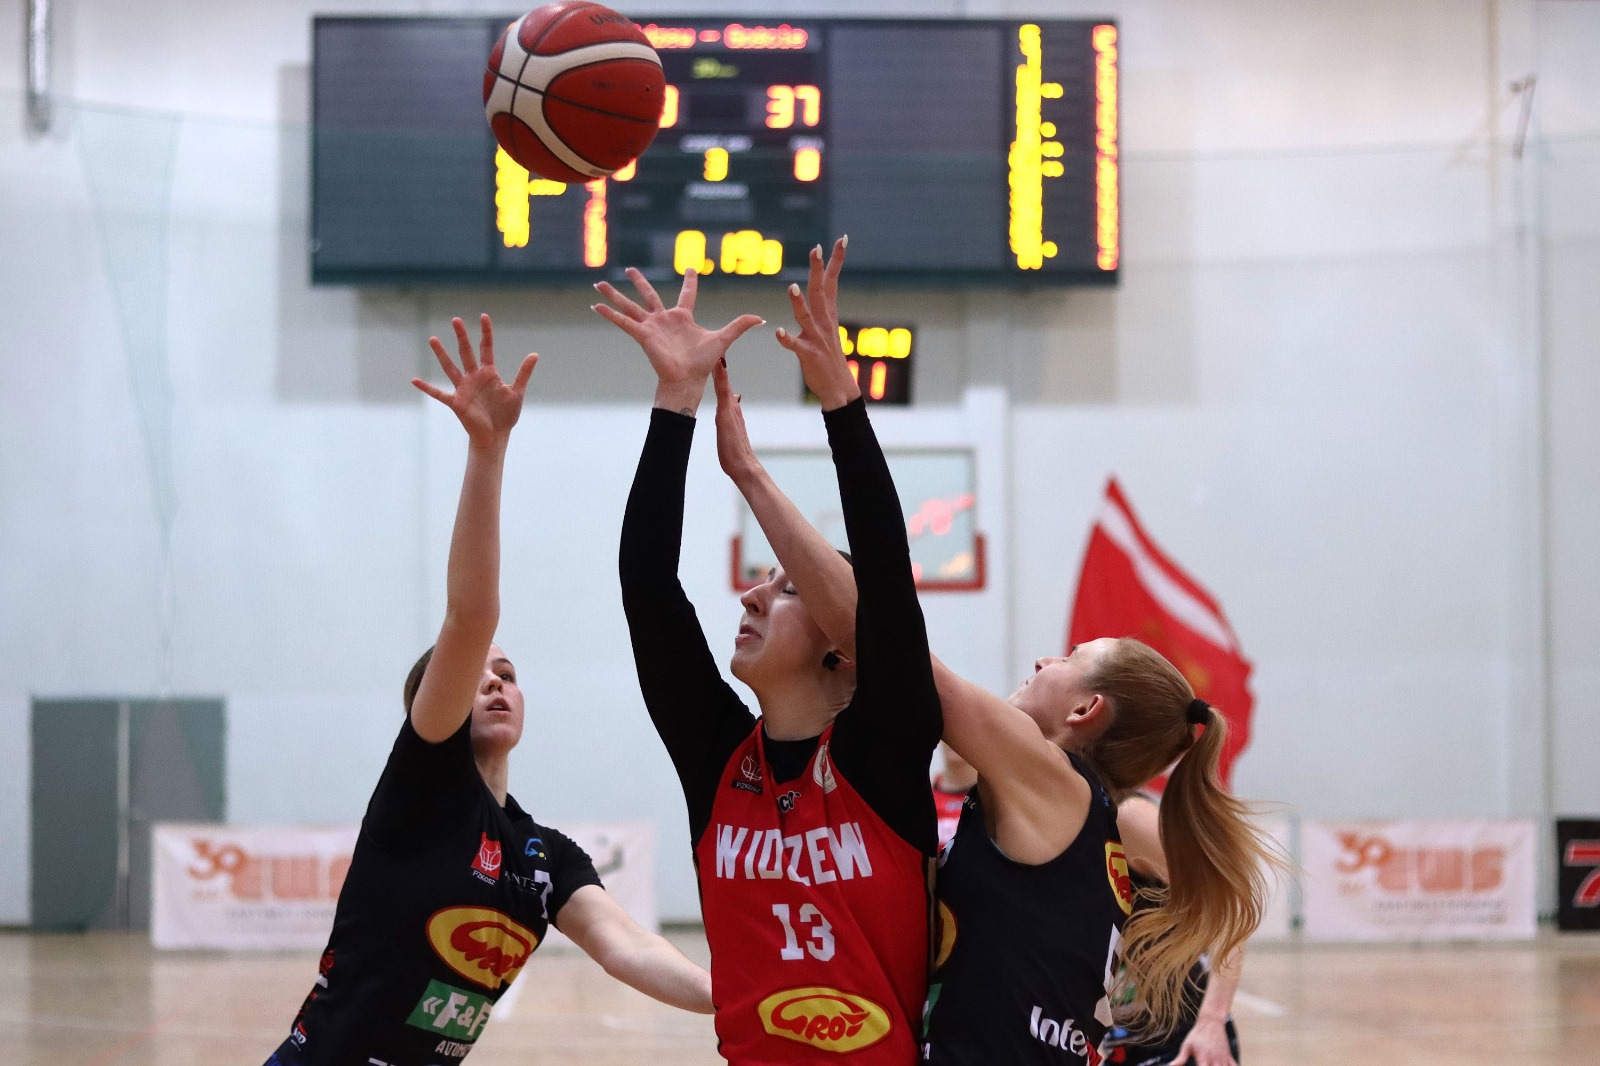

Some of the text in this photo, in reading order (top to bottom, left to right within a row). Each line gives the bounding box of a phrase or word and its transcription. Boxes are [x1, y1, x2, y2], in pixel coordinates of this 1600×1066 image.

[765, 85, 820, 128] 37
[716, 822, 873, 887] WIDZEW
[772, 903, 836, 962] 13
[1030, 1005, 1088, 1057] Inte
